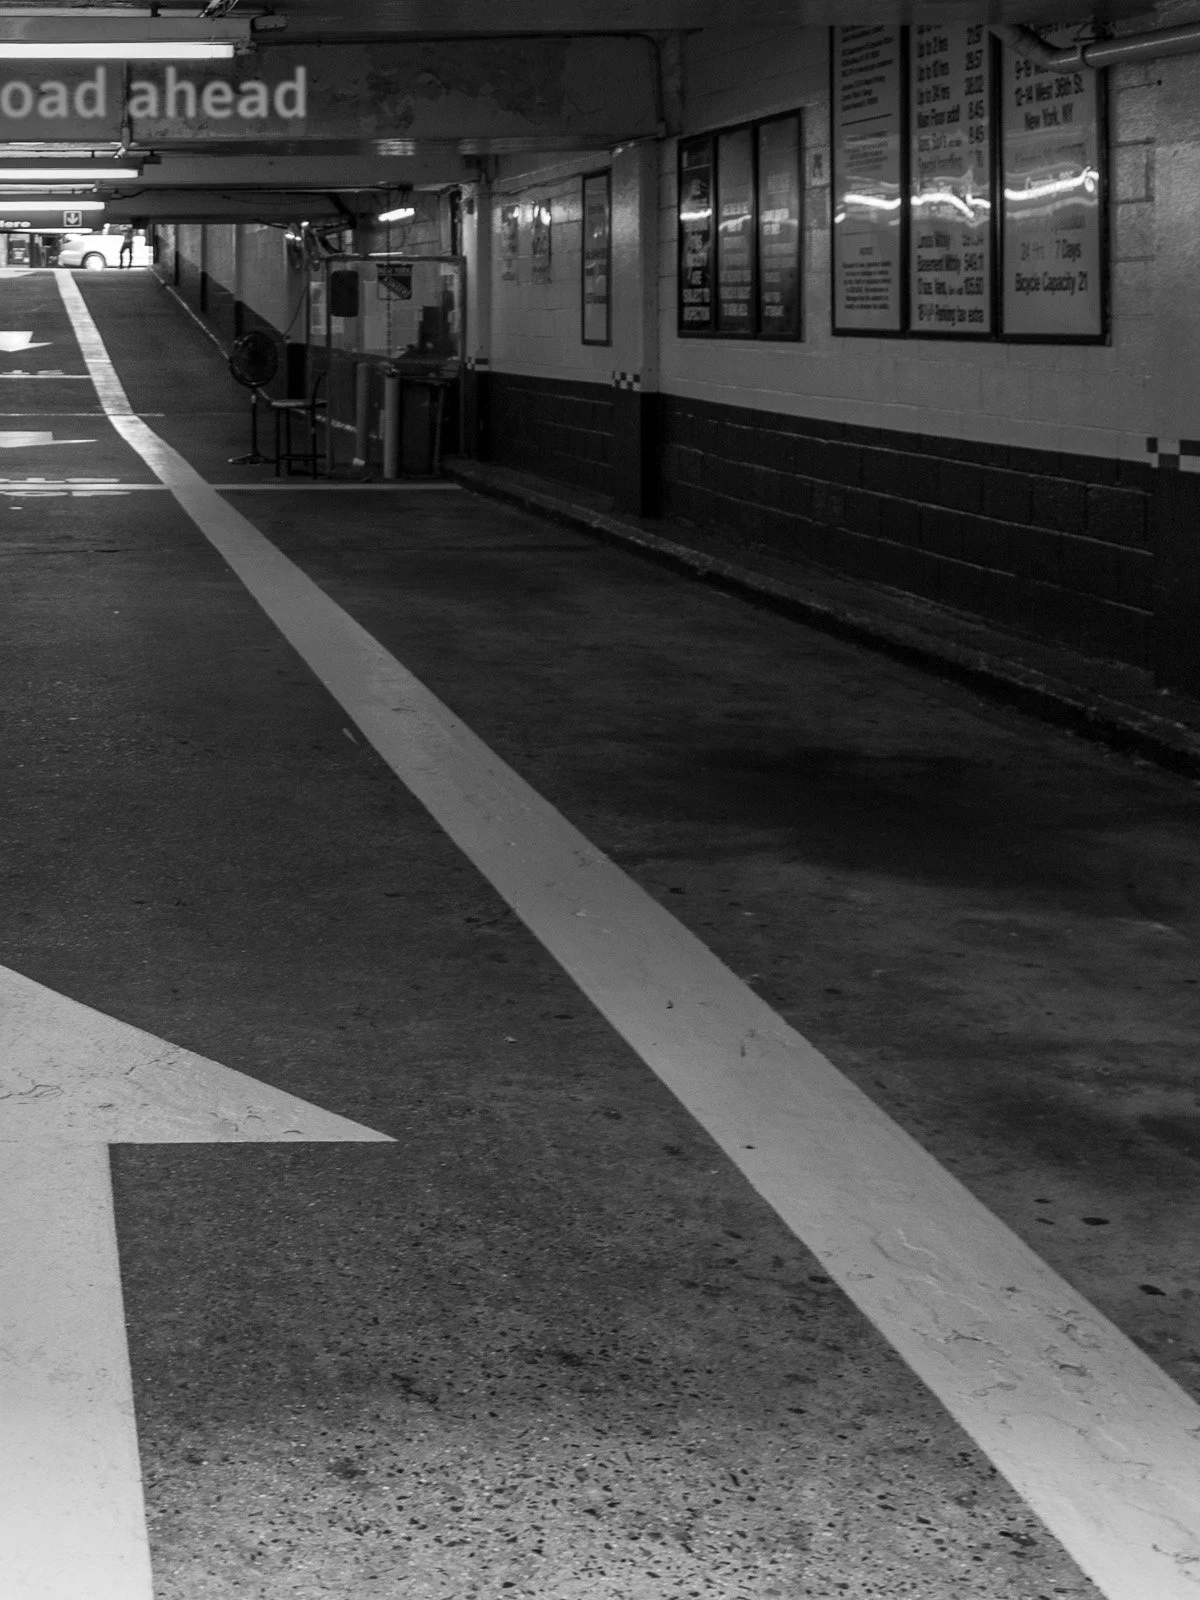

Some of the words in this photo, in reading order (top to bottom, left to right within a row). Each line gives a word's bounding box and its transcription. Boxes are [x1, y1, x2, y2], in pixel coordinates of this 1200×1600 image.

[1025, 112, 1040, 131] New
[1062, 102, 1073, 124] NY
[1061, 239, 1081, 262] Days
[1015, 272, 1040, 295] Bicycle
[1043, 271, 1076, 296] Capacity
